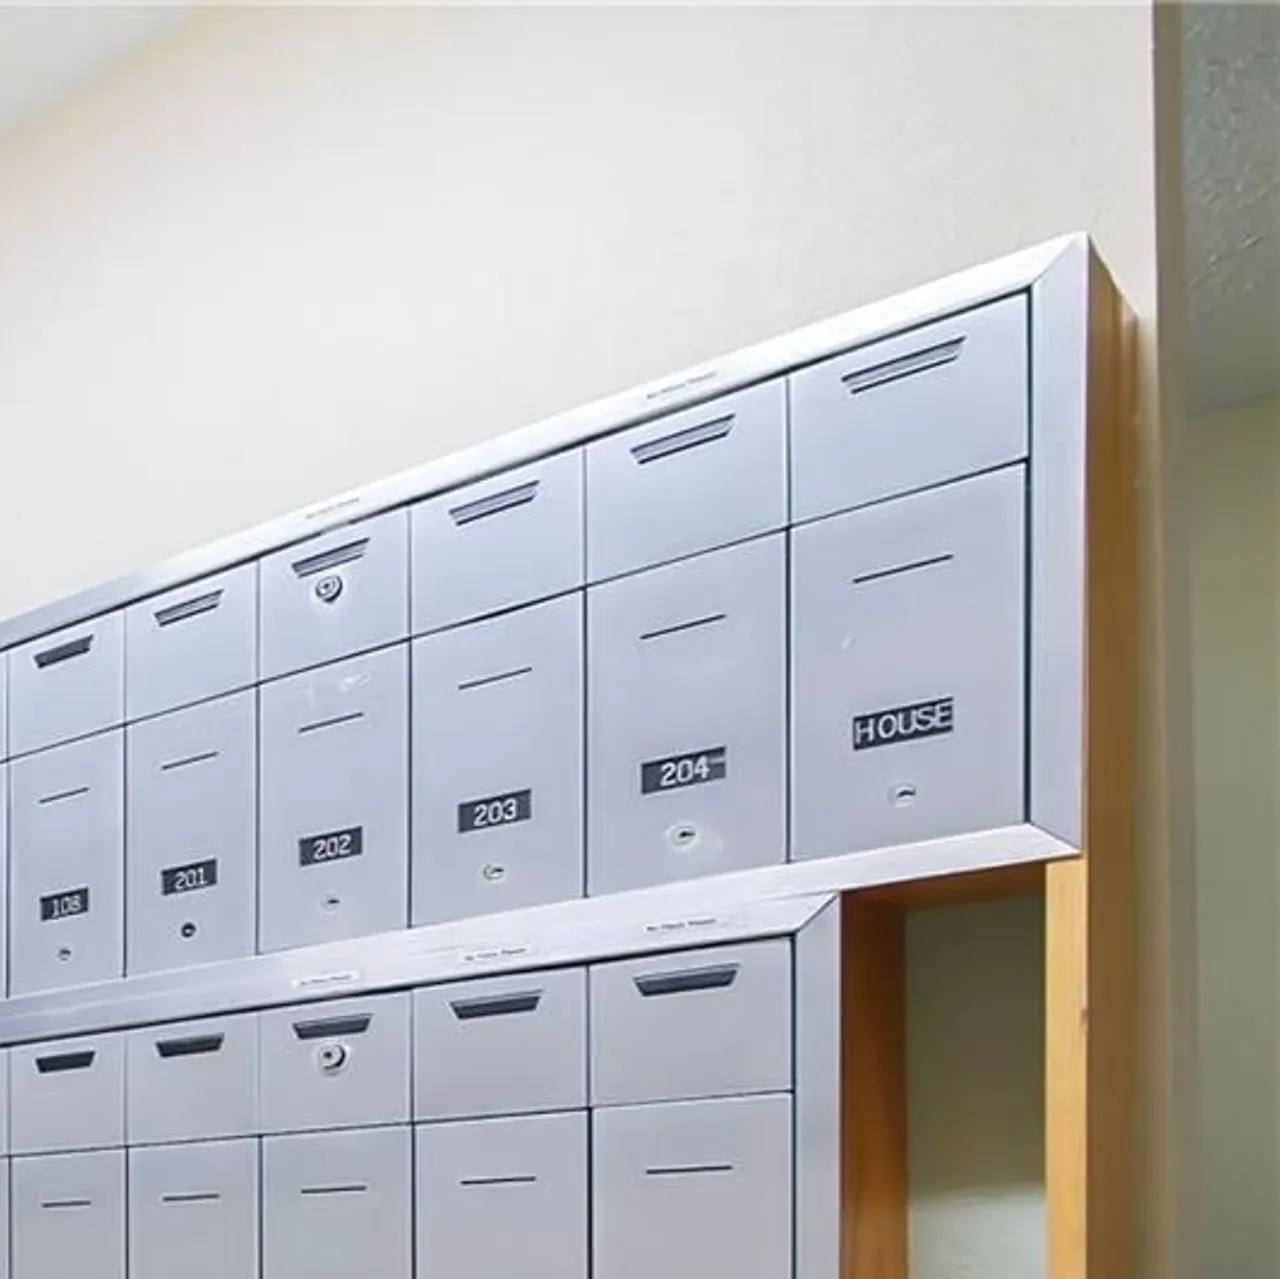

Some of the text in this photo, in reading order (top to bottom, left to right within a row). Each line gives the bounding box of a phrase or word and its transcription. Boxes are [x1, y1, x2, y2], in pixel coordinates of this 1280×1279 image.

[854, 702, 953, 744] HOUSE
[659, 755, 710, 787] 204
[473, 798, 518, 827] 203
[312, 833, 352, 860] 202
[173, 867, 208, 891] 201
